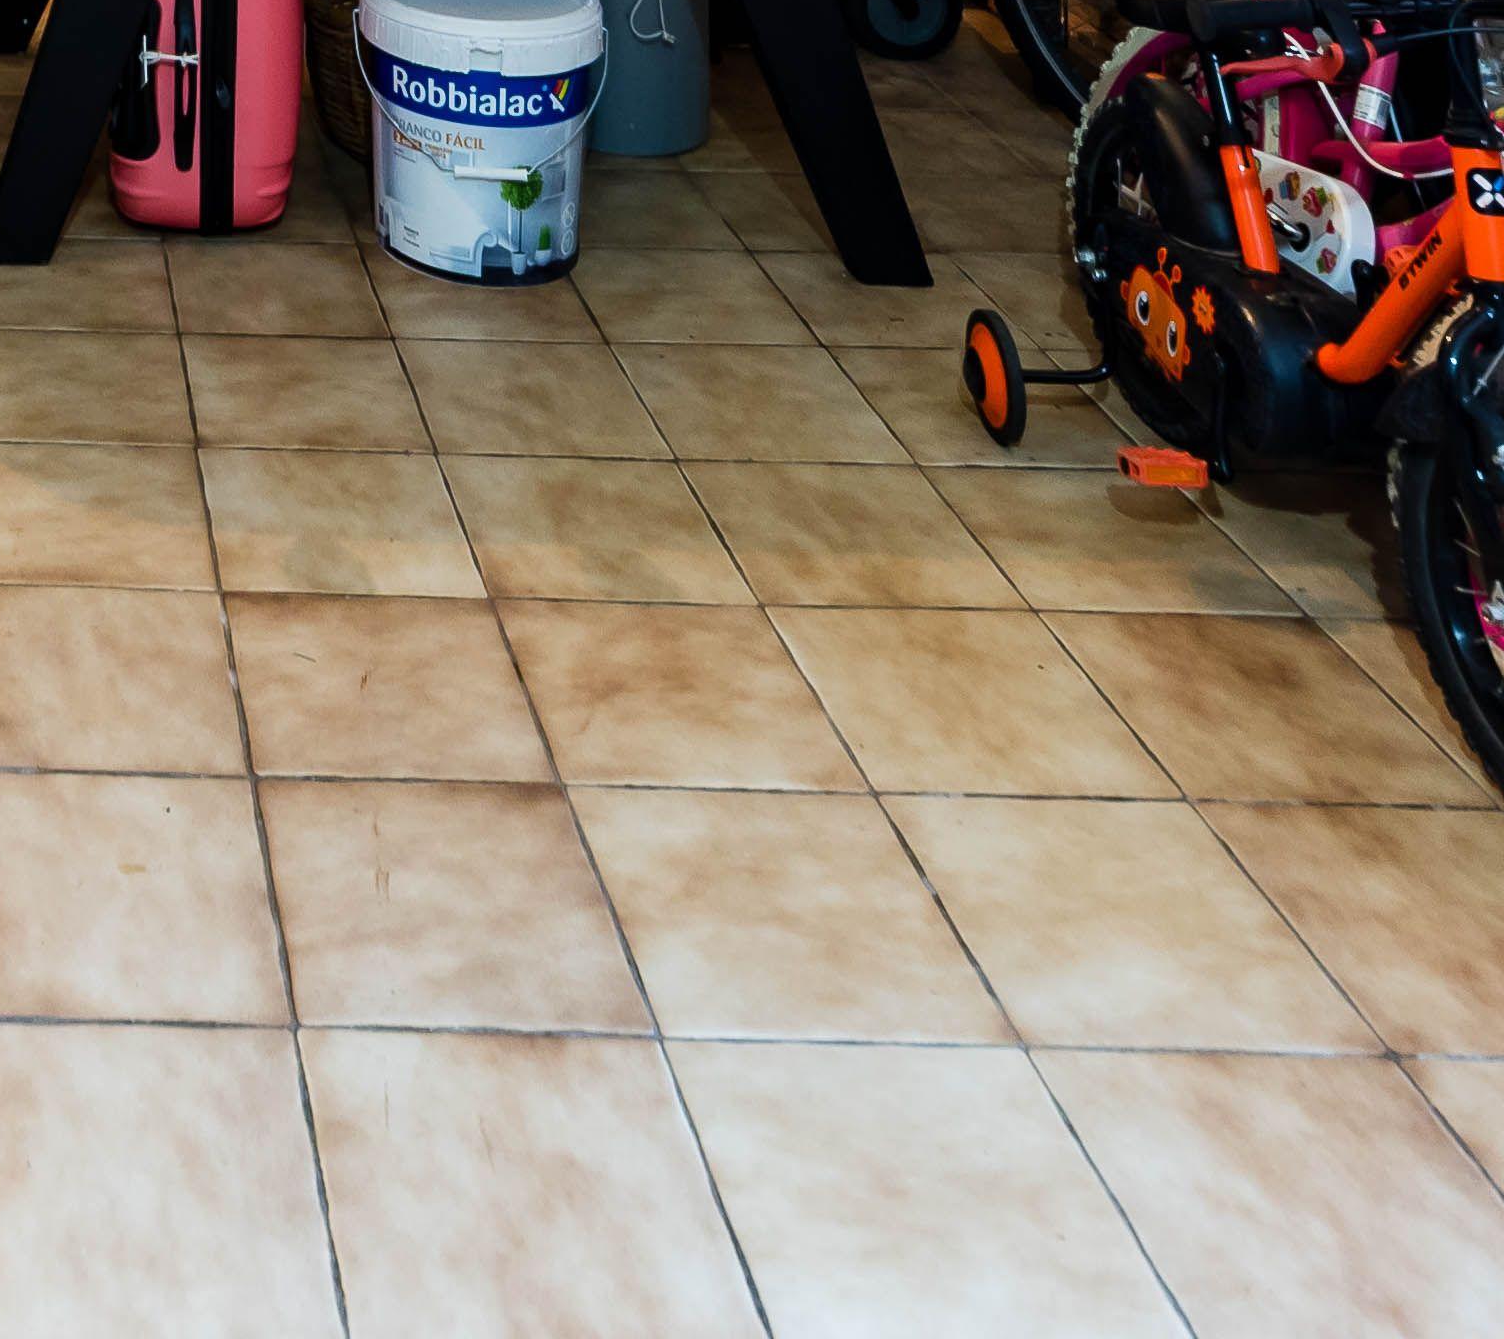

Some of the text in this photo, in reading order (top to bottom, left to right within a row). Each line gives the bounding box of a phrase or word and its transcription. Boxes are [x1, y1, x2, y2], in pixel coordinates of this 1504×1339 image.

[392, 65, 543, 117] Robbialac
[394, 117, 485, 151] ANCO FÁCIL
